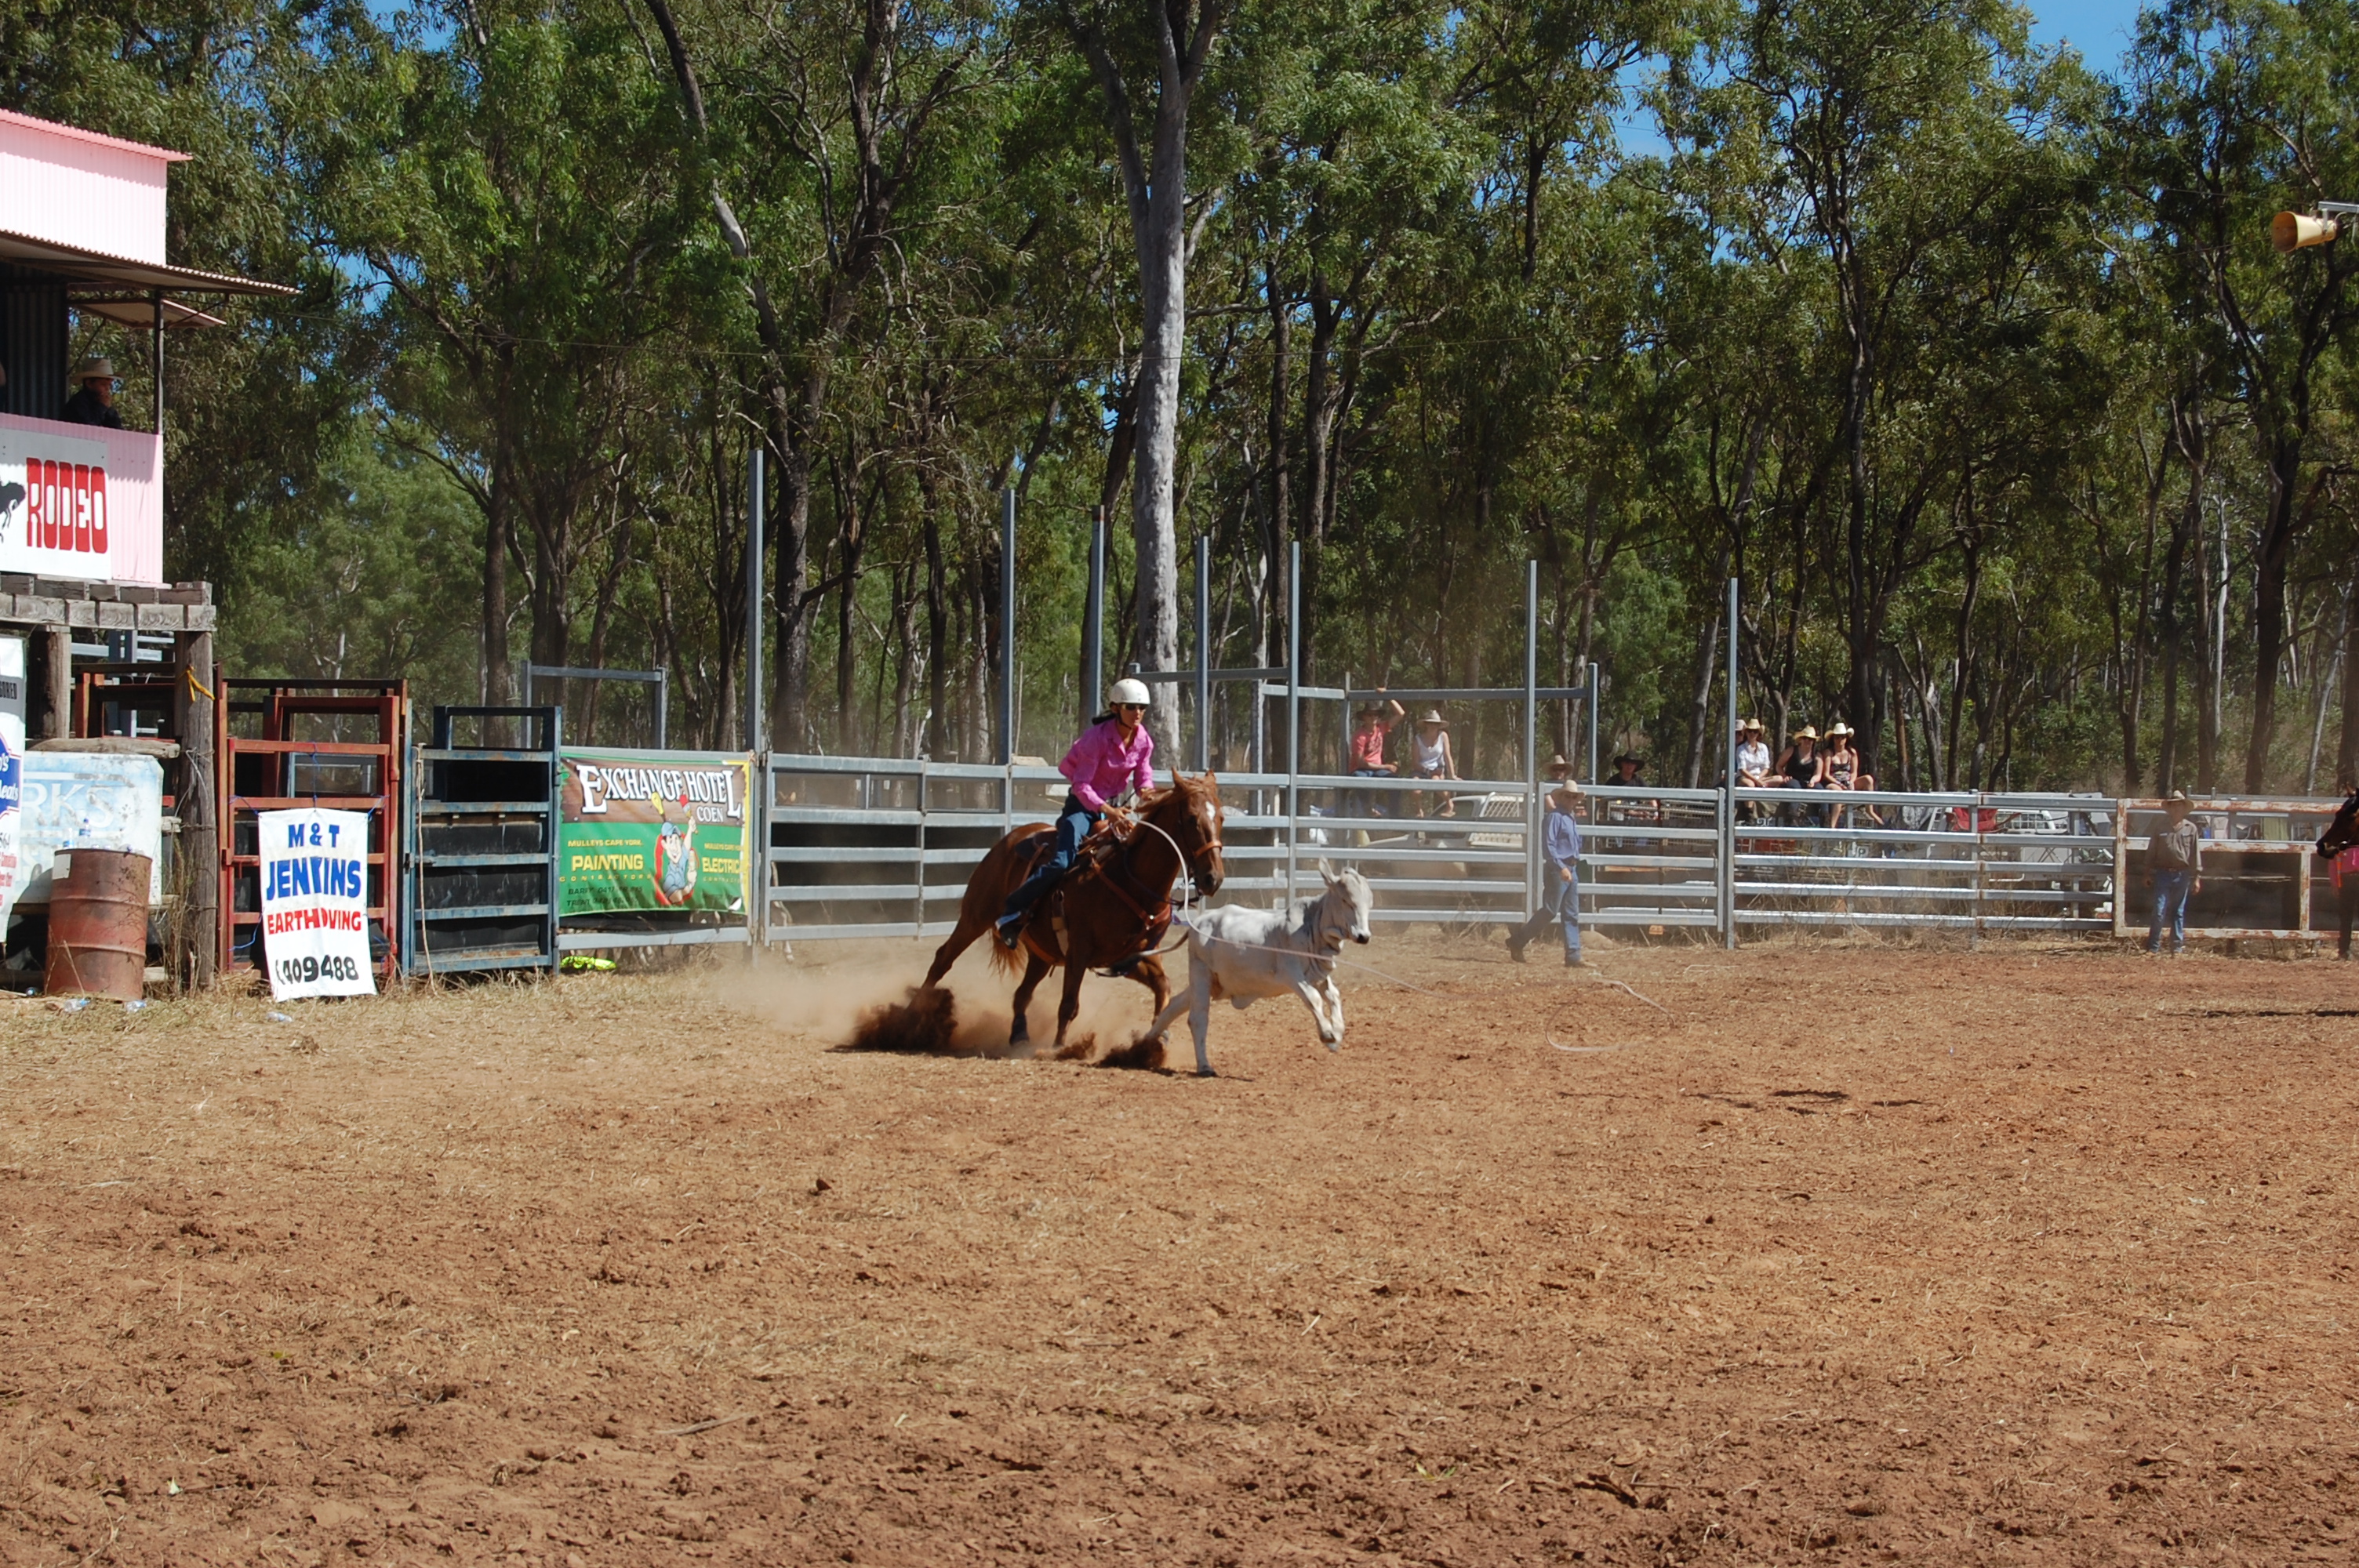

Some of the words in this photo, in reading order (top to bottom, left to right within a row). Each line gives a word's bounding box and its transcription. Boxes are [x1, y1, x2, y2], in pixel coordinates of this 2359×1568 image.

[27, 457, 107, 554] RODEO
[0, 779, 19, 801] eats
[576, 764, 684, 813] EXCHANGE
[684, 770, 741, 818] HOTEL
[696, 806, 723, 822] COEN
[288, 824, 305, 848] M
[309, 822, 322, 845] &
[329, 825, 340, 848] T
[572, 854, 644, 872] PAINTING
[267, 856, 361, 901] JENKINS
[559, 873, 652, 882] CONTRACTORS
[267, 907, 362, 935] EARTHOVING
